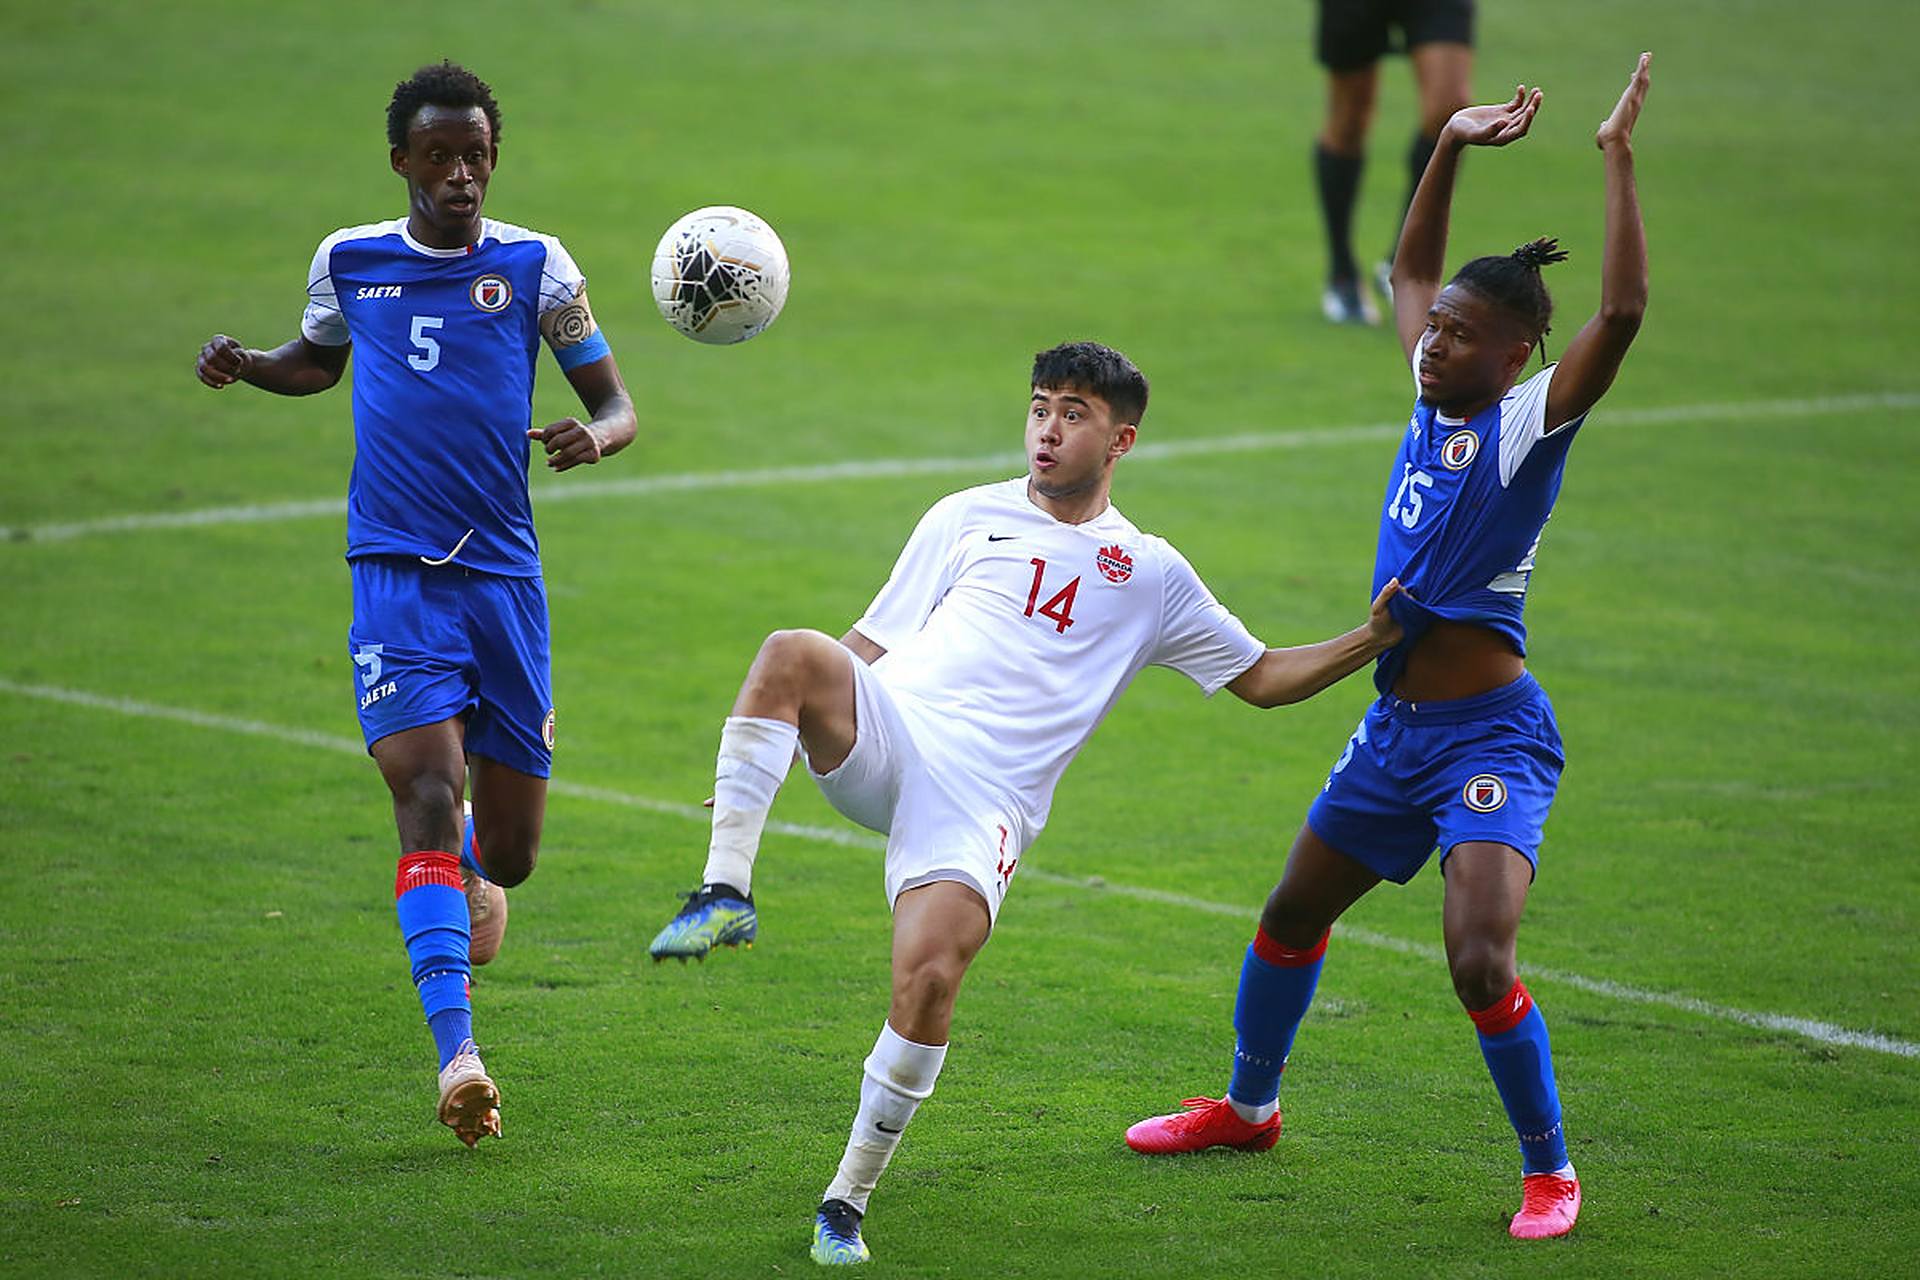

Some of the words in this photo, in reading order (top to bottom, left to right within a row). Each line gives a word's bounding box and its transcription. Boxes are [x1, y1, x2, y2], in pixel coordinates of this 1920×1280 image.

[357, 286, 402, 300] SAETA
[407, 315, 444, 372] 5
[1389, 462, 1434, 528] 15
[1096, 554, 1133, 573] CANADA
[1024, 557, 1081, 634] 14
[354, 643, 384, 688] 5
[361, 681, 397, 710] SAETA
